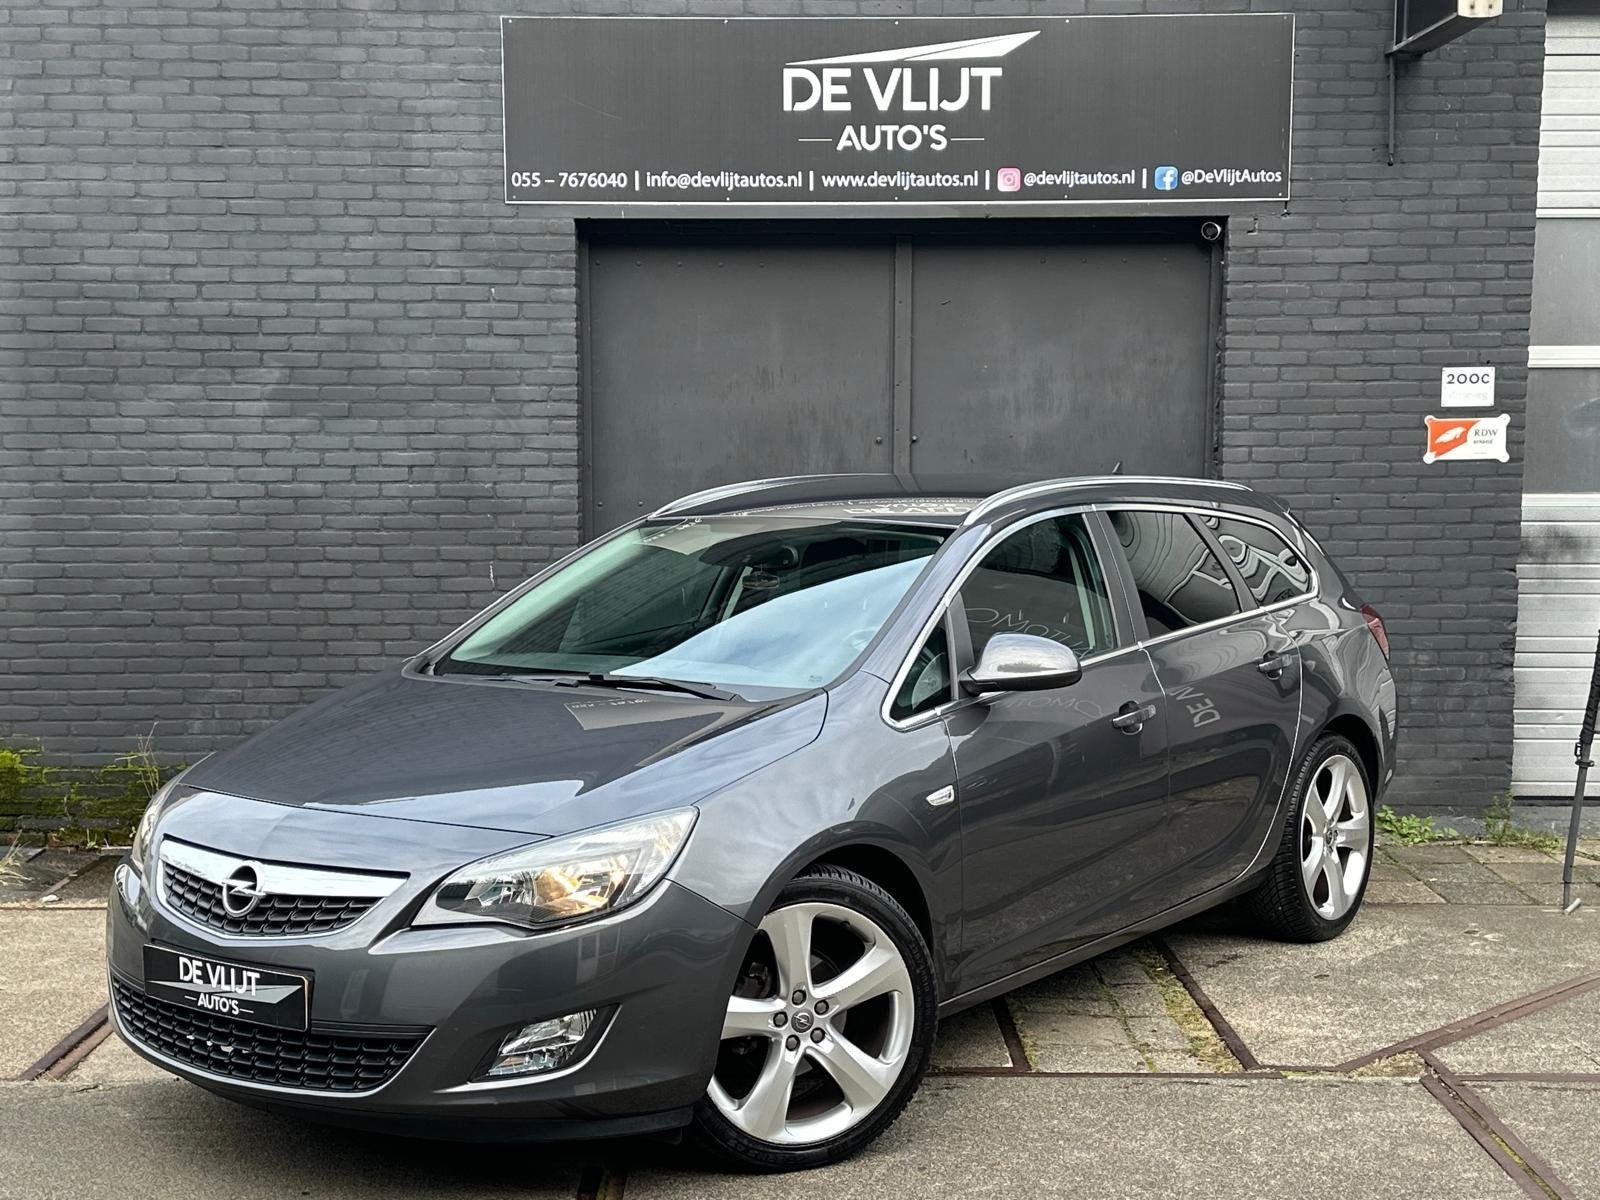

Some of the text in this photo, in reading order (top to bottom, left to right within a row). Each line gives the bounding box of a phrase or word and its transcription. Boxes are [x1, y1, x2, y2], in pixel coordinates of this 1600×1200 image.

[782, 66, 1003, 112] DE VLIJT
[836, 124, 949, 152] AUTO'S
[511, 171, 542, 188] 055
[558, 171, 628, 189] 7676040
[646, 170, 803, 192] info@devlijtautos.nl
[821, 170, 979, 191] www.devlijtautos.nl
[1023, 168, 1136, 189] @devlijtautos.nl
[1181, 167, 1282, 187] @DeVlijtAutos
[1446, 373, 1490, 385] 200C
[1473, 428, 1499, 437] RDW
[178, 956, 261, 996] DE VLIJT
[197, 992, 240, 1015] AUTO'S
